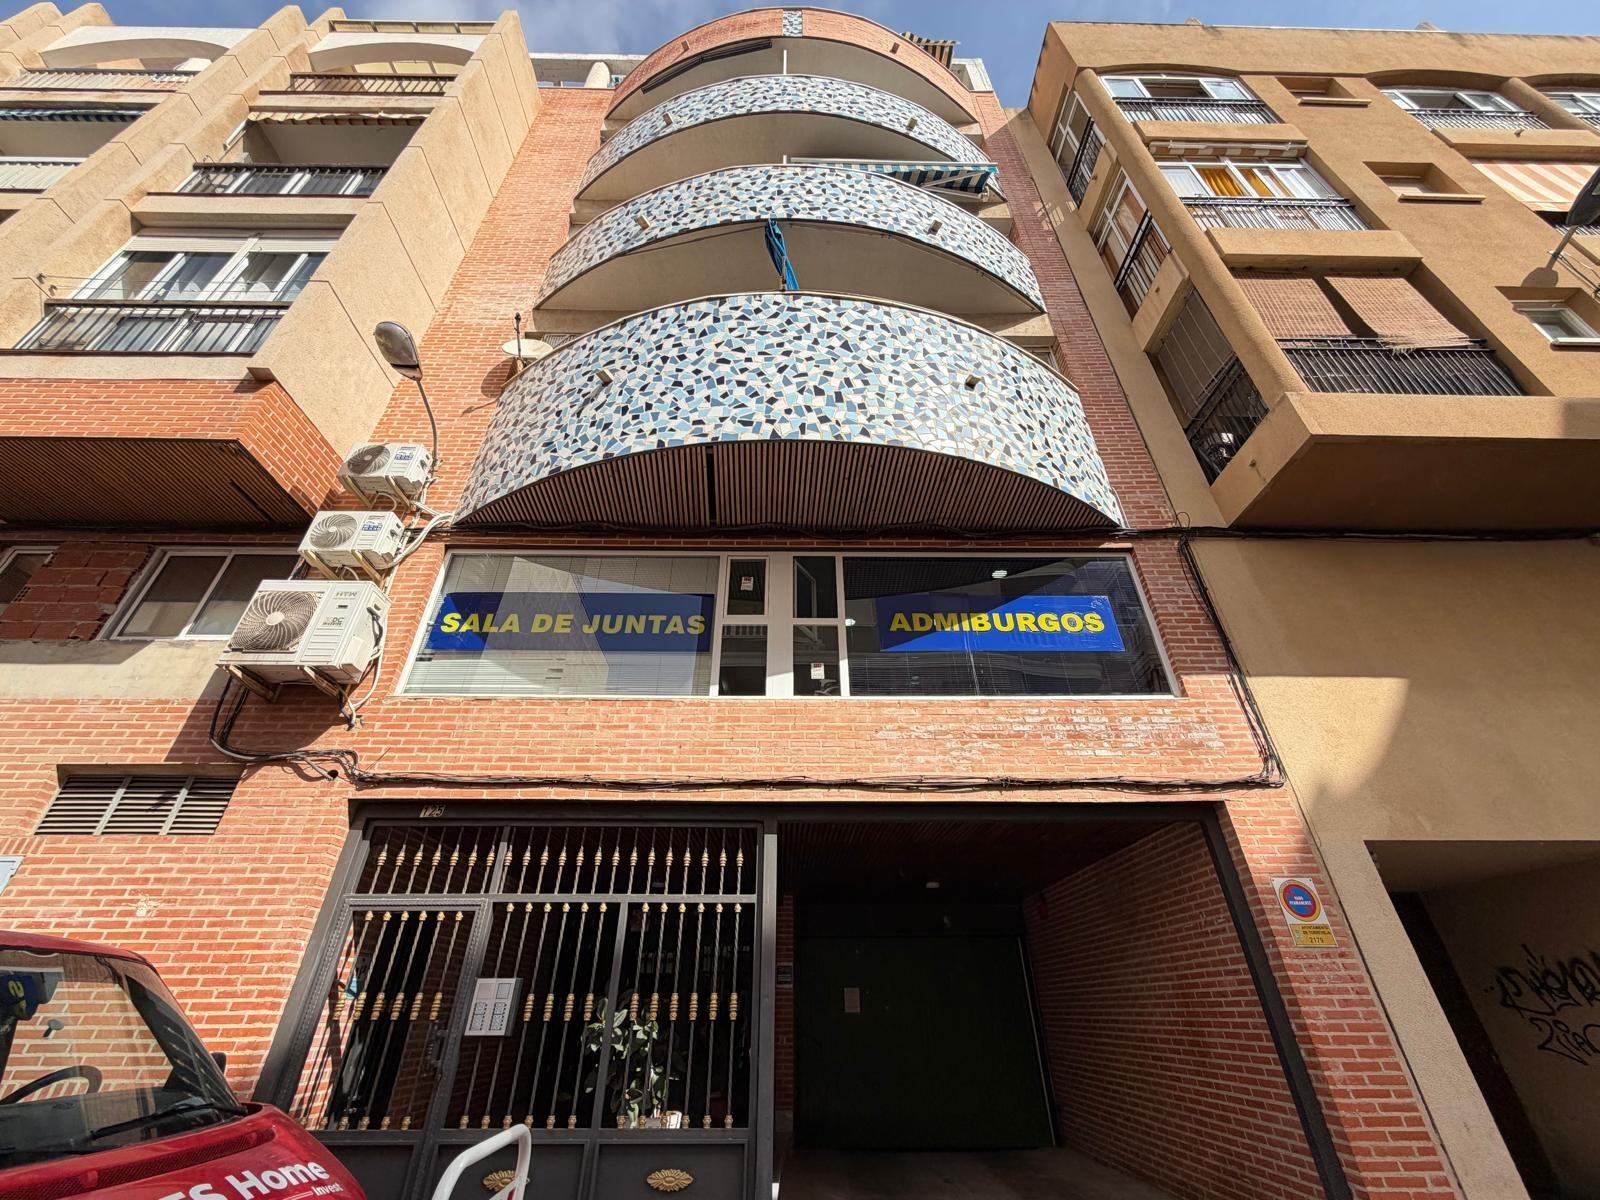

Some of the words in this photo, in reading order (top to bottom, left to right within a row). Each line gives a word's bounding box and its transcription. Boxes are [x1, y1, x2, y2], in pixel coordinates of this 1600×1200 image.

[440, 612, 520, 633] SALA
[530, 613, 575, 633] DE
[582, 614, 706, 635] JUNTAS
[889, 612, 1106, 633] ADMIBURGOS
[225, 1161, 330, 1200] Home
[312, 1182, 343, 1196] Invest
